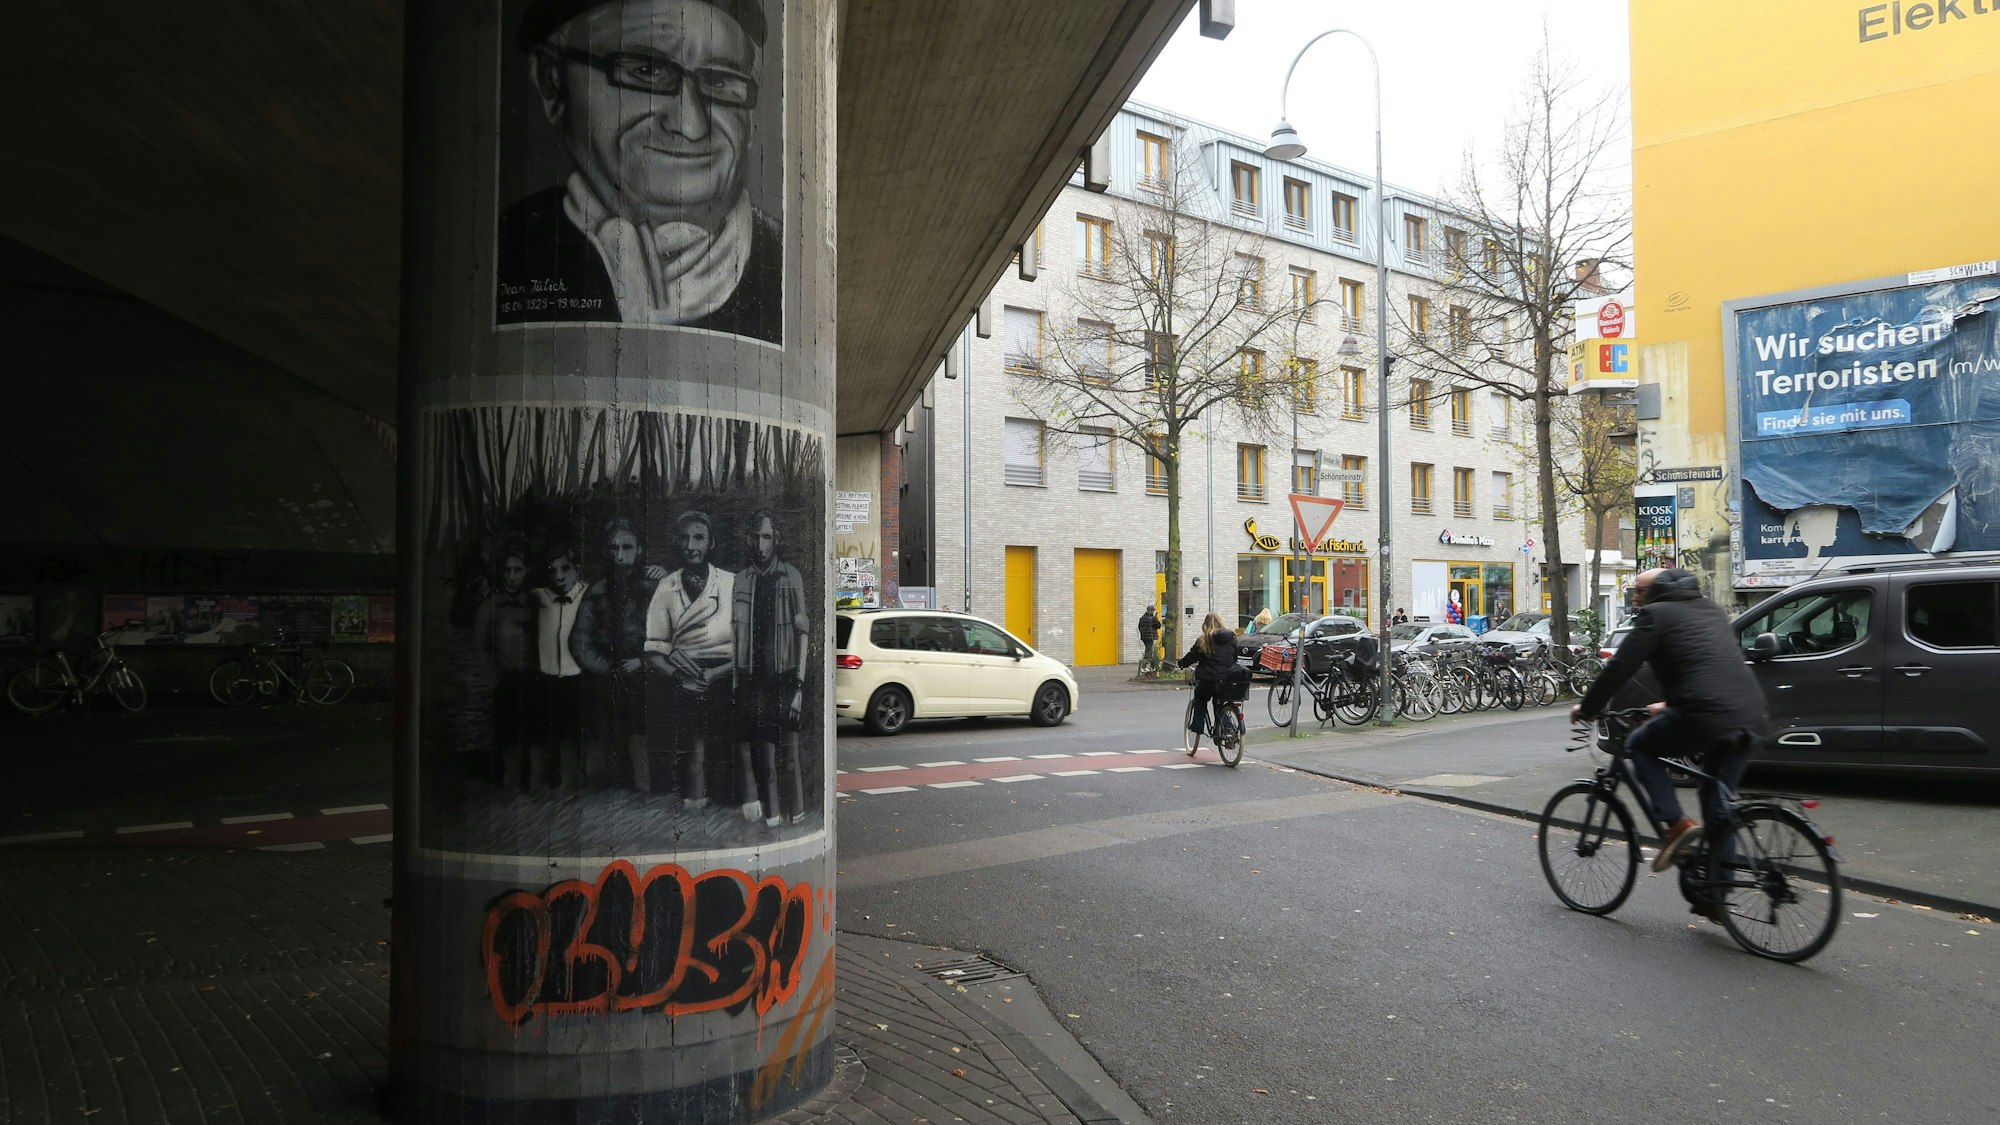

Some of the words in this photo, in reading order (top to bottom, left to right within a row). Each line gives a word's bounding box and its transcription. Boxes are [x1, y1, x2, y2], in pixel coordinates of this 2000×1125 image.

[1949, 262, 1990, 276] SCHWARZ
[1755, 333, 1809, 361] Wir
[1819, 322, 1941, 355] suchen
[1571, 343, 1586, 359] ATM
[1756, 358, 1937, 396] Terroristen
[1763, 414, 1808, 430] Finde
[1812, 413, 1835, 426] sie
[1840, 408, 1867, 423] mit
[1872, 408, 1905, 420] uns.
[1638, 505, 1673, 515] KIOSK
[1651, 516, 1671, 526] 358
[1761, 524, 1784, 533] Kom
[1450, 534, 1478, 545] Domino's
[1479, 536, 1495, 546] Pizza
